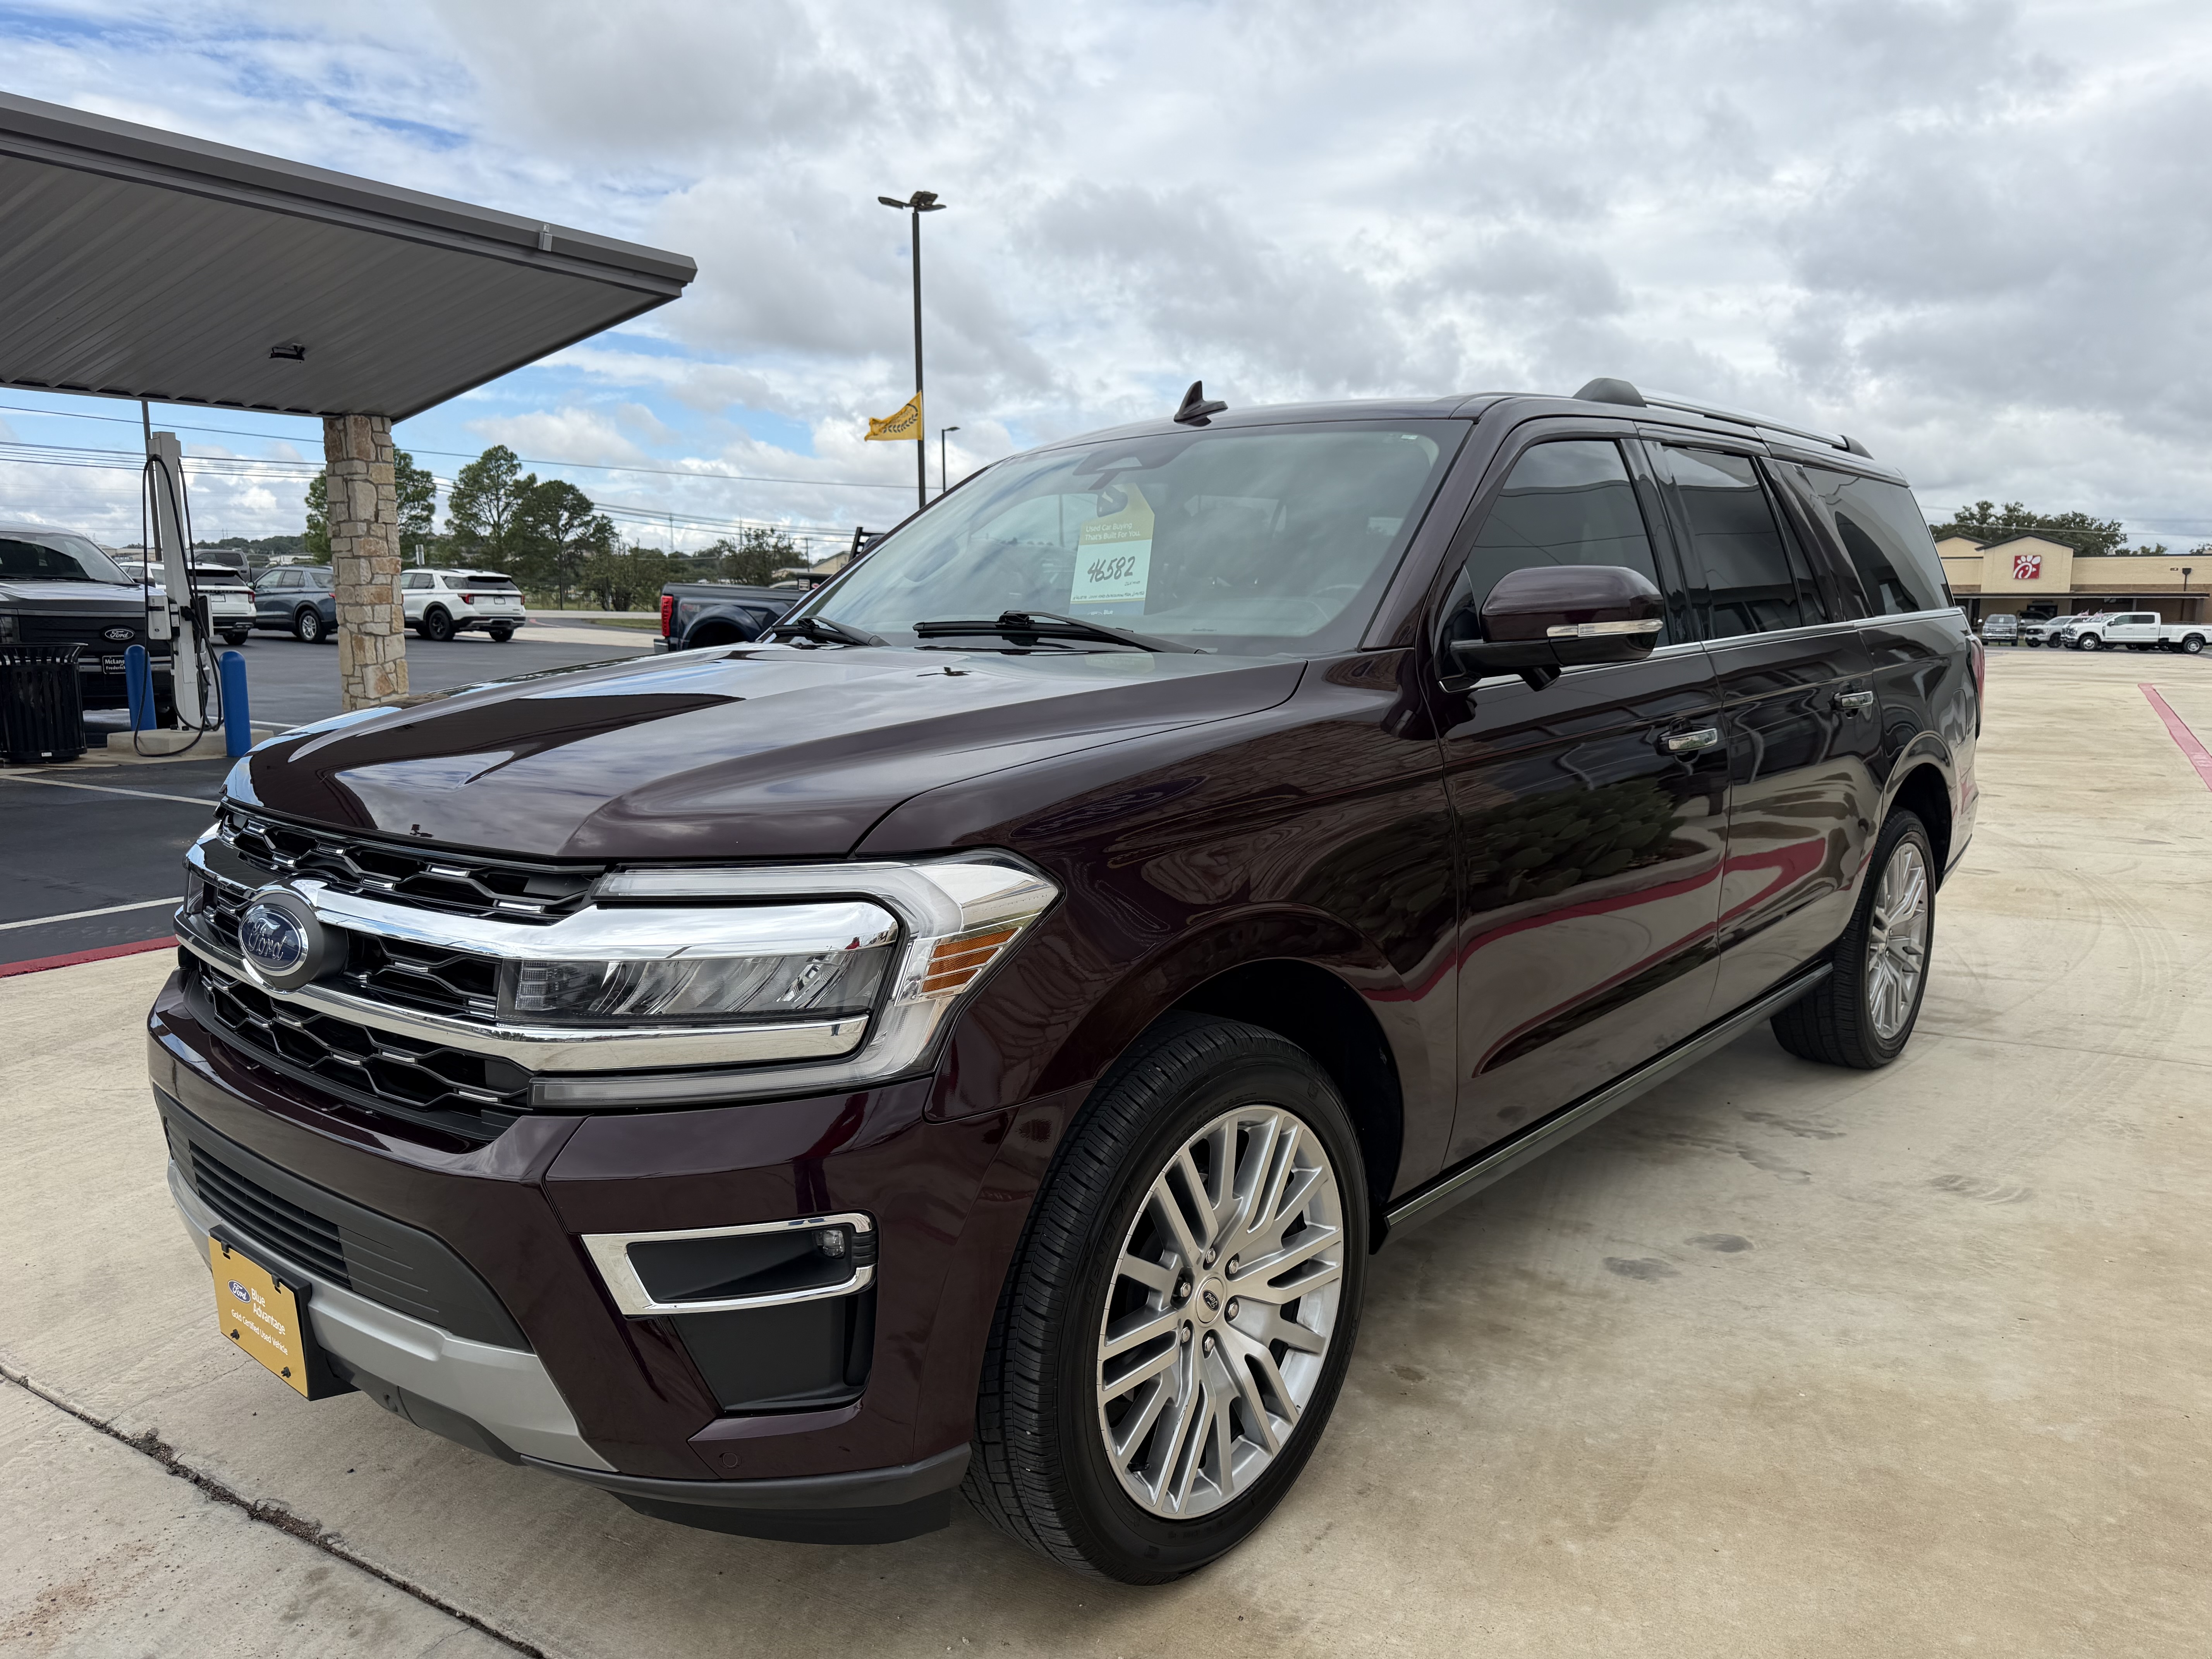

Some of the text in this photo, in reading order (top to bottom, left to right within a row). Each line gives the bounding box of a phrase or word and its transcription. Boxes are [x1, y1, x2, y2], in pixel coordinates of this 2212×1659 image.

[1086, 524, 1101, 532] Used
[1087, 556, 1135, 583] 46582
[248, 917, 287, 961] Ford
[232, 1283, 247, 1300] Ford
[251, 1288, 265, 1307] Blue
[1205, 1293, 1218, 1309] Ford
[253, 1303, 285, 1335] Advantage
[231, 1309, 288, 1355] Gold Certified Used Vehicle
